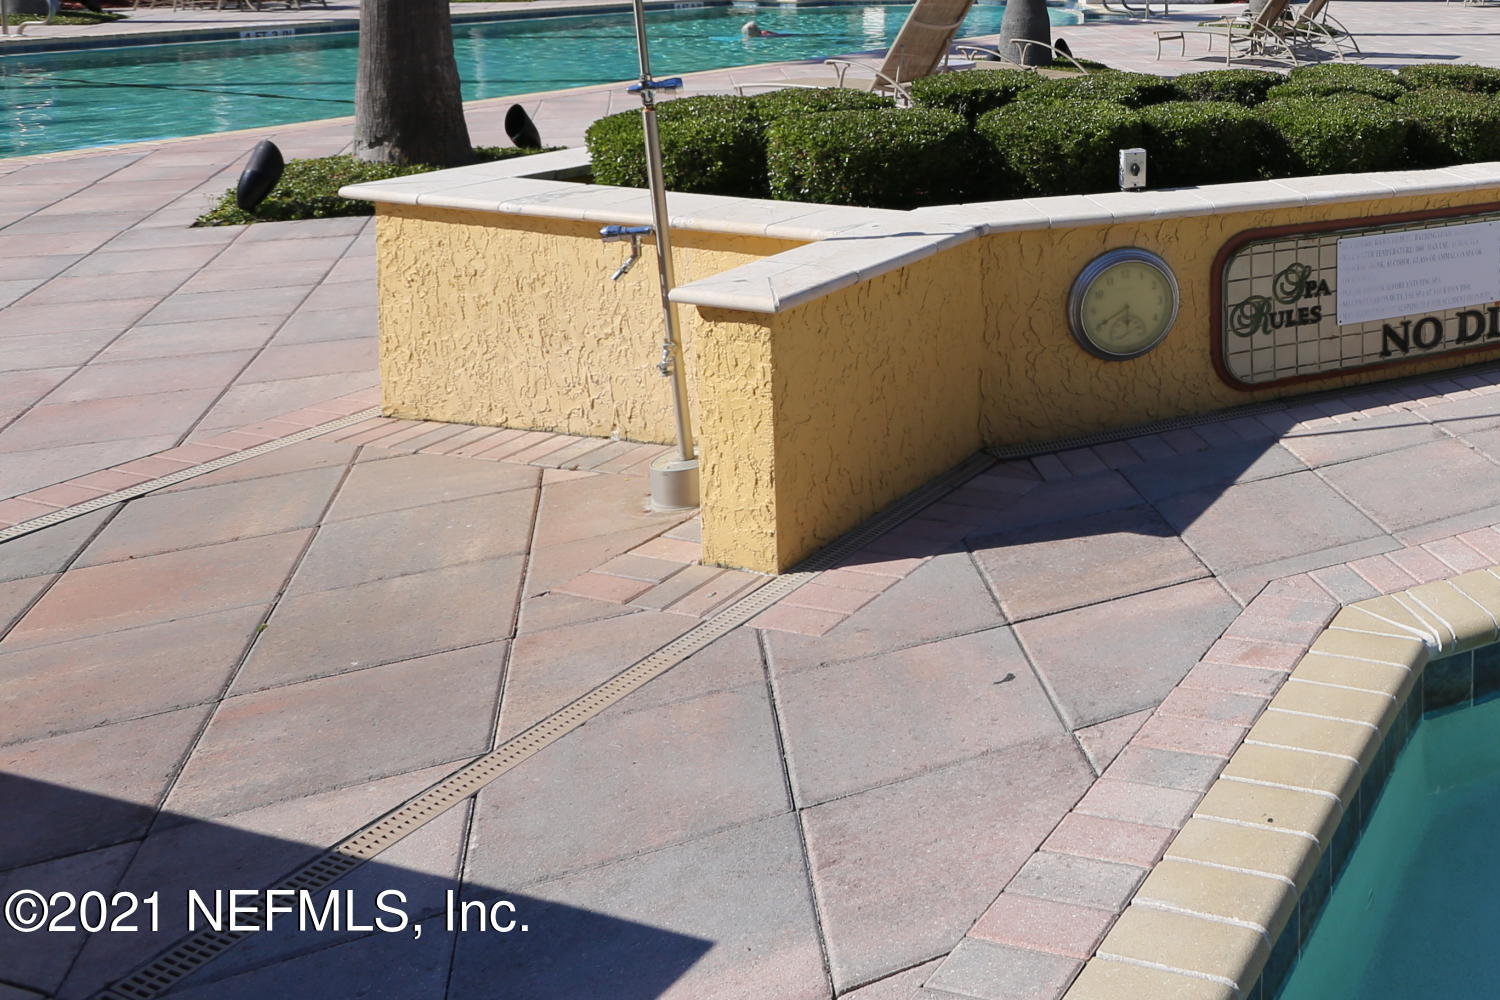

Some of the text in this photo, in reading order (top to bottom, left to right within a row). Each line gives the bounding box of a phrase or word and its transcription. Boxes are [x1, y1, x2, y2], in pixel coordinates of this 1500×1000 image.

[1272, 263, 1332, 305] SPA
[1229, 295, 1323, 338] RULES
[1379, 318, 1445, 358] NO
